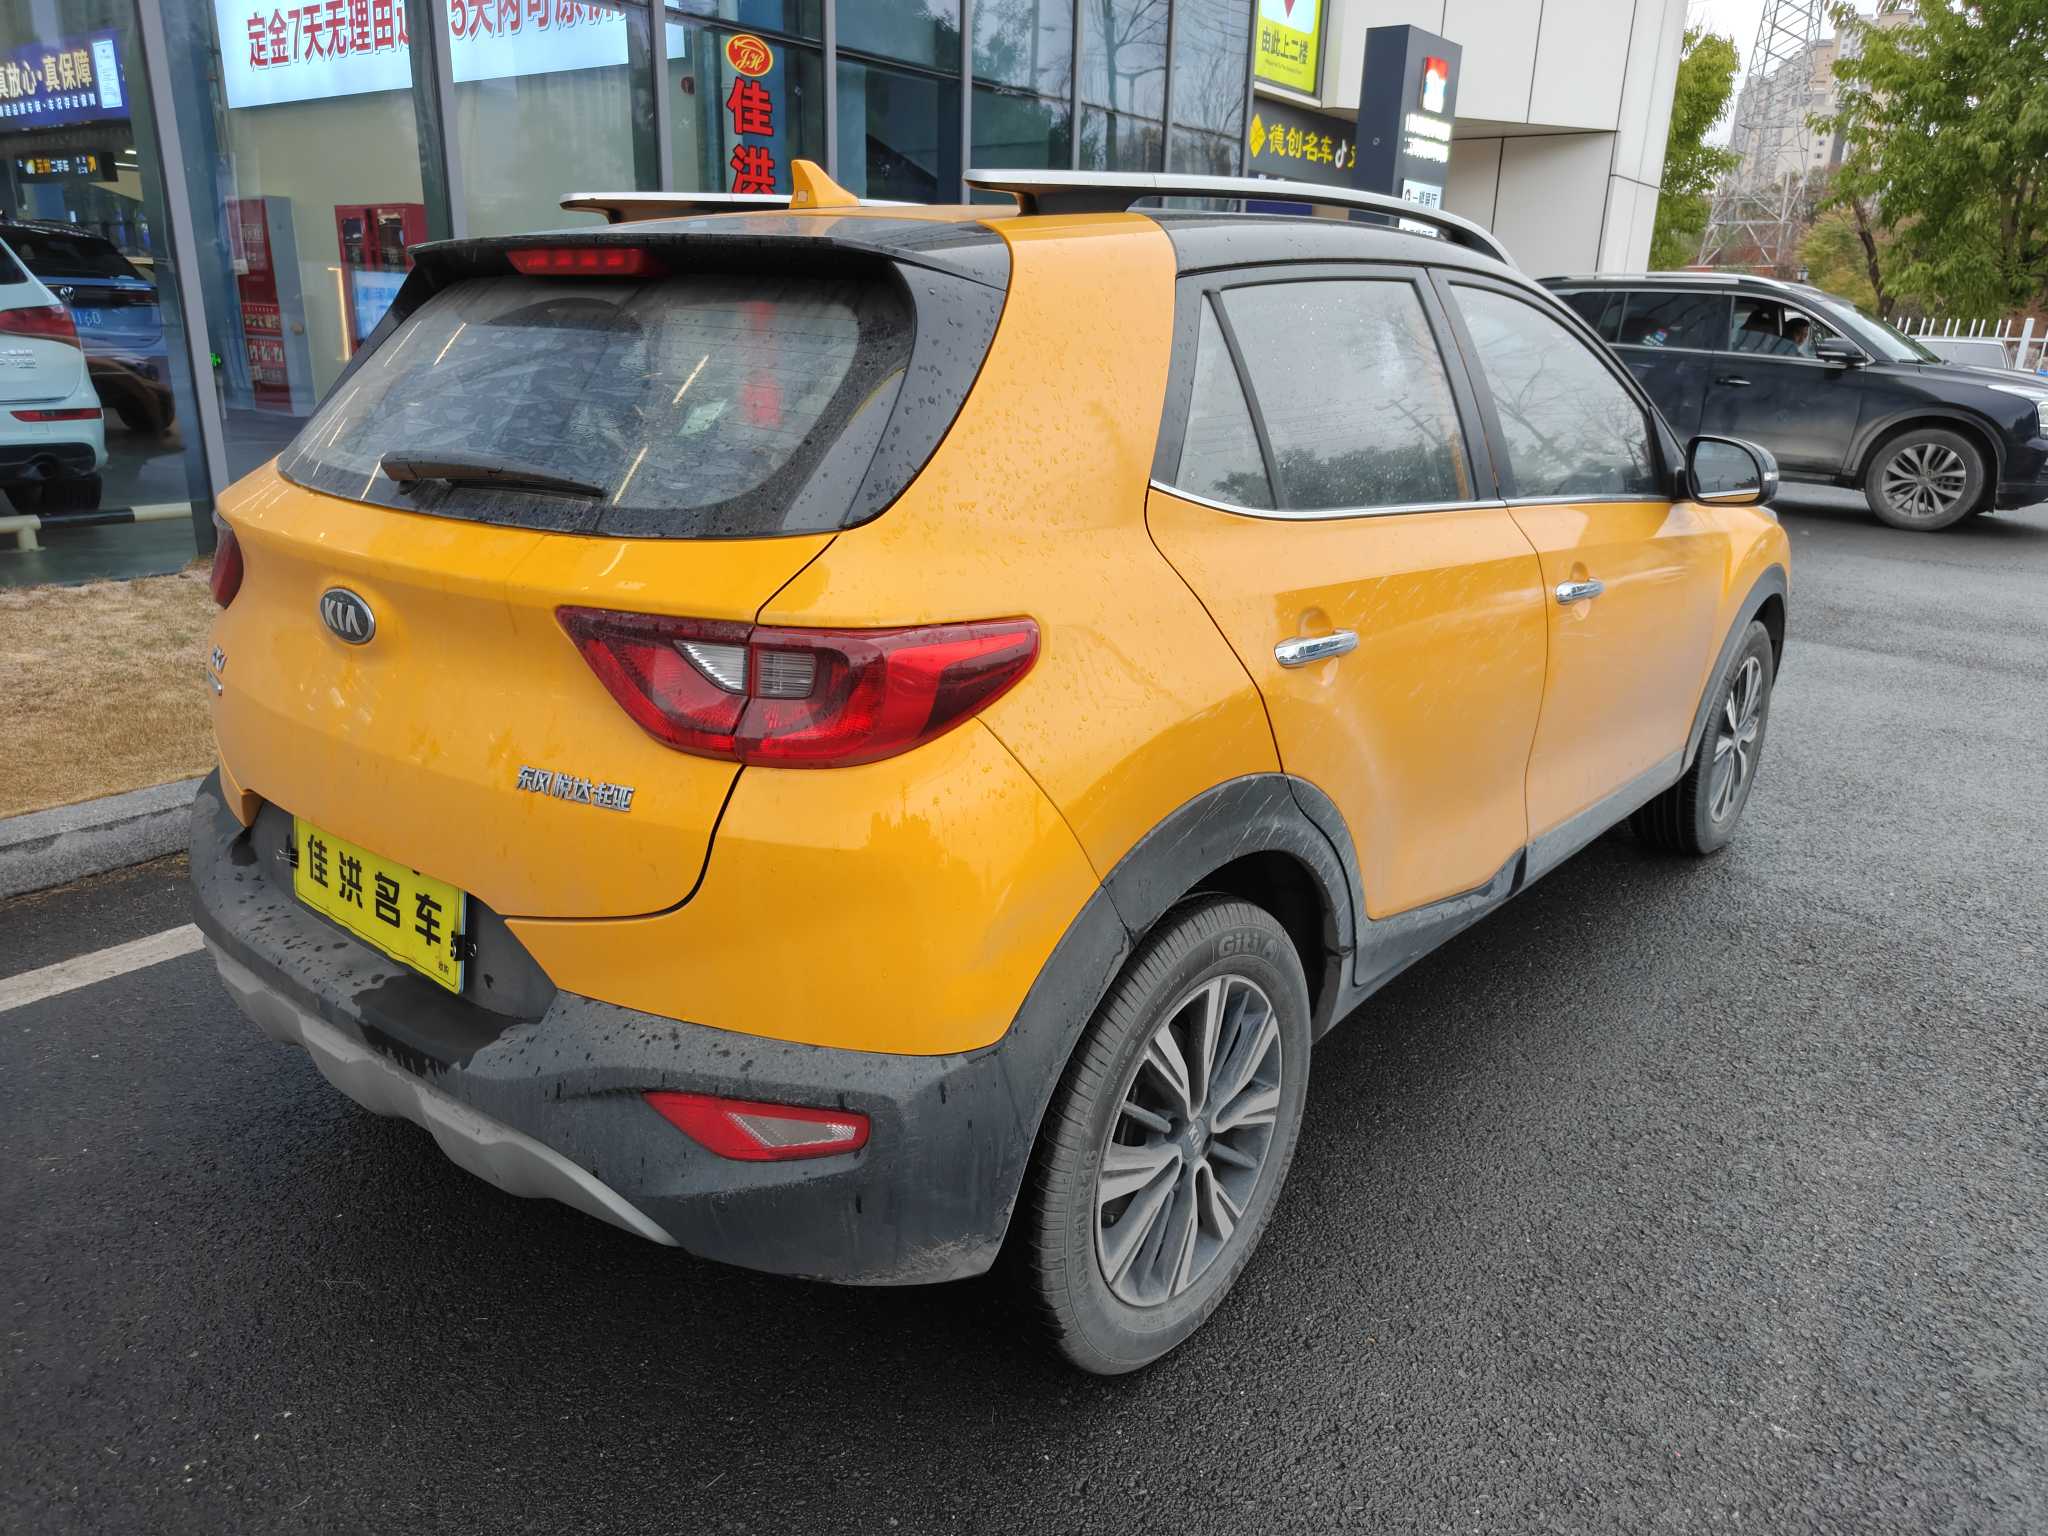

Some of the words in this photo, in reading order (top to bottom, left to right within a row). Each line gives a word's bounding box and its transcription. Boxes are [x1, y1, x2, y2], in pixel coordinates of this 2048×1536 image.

[1262, 29, 1309, 65] 由此上二楼
[726, 76, 776, 194] 佳洪
[1268, 123, 1333, 165] 德创名车
[323, 597, 363, 636] KIA
[517, 765, 635, 812] 东风悦达起亚
[307, 834, 443, 946] 佳洪名车
